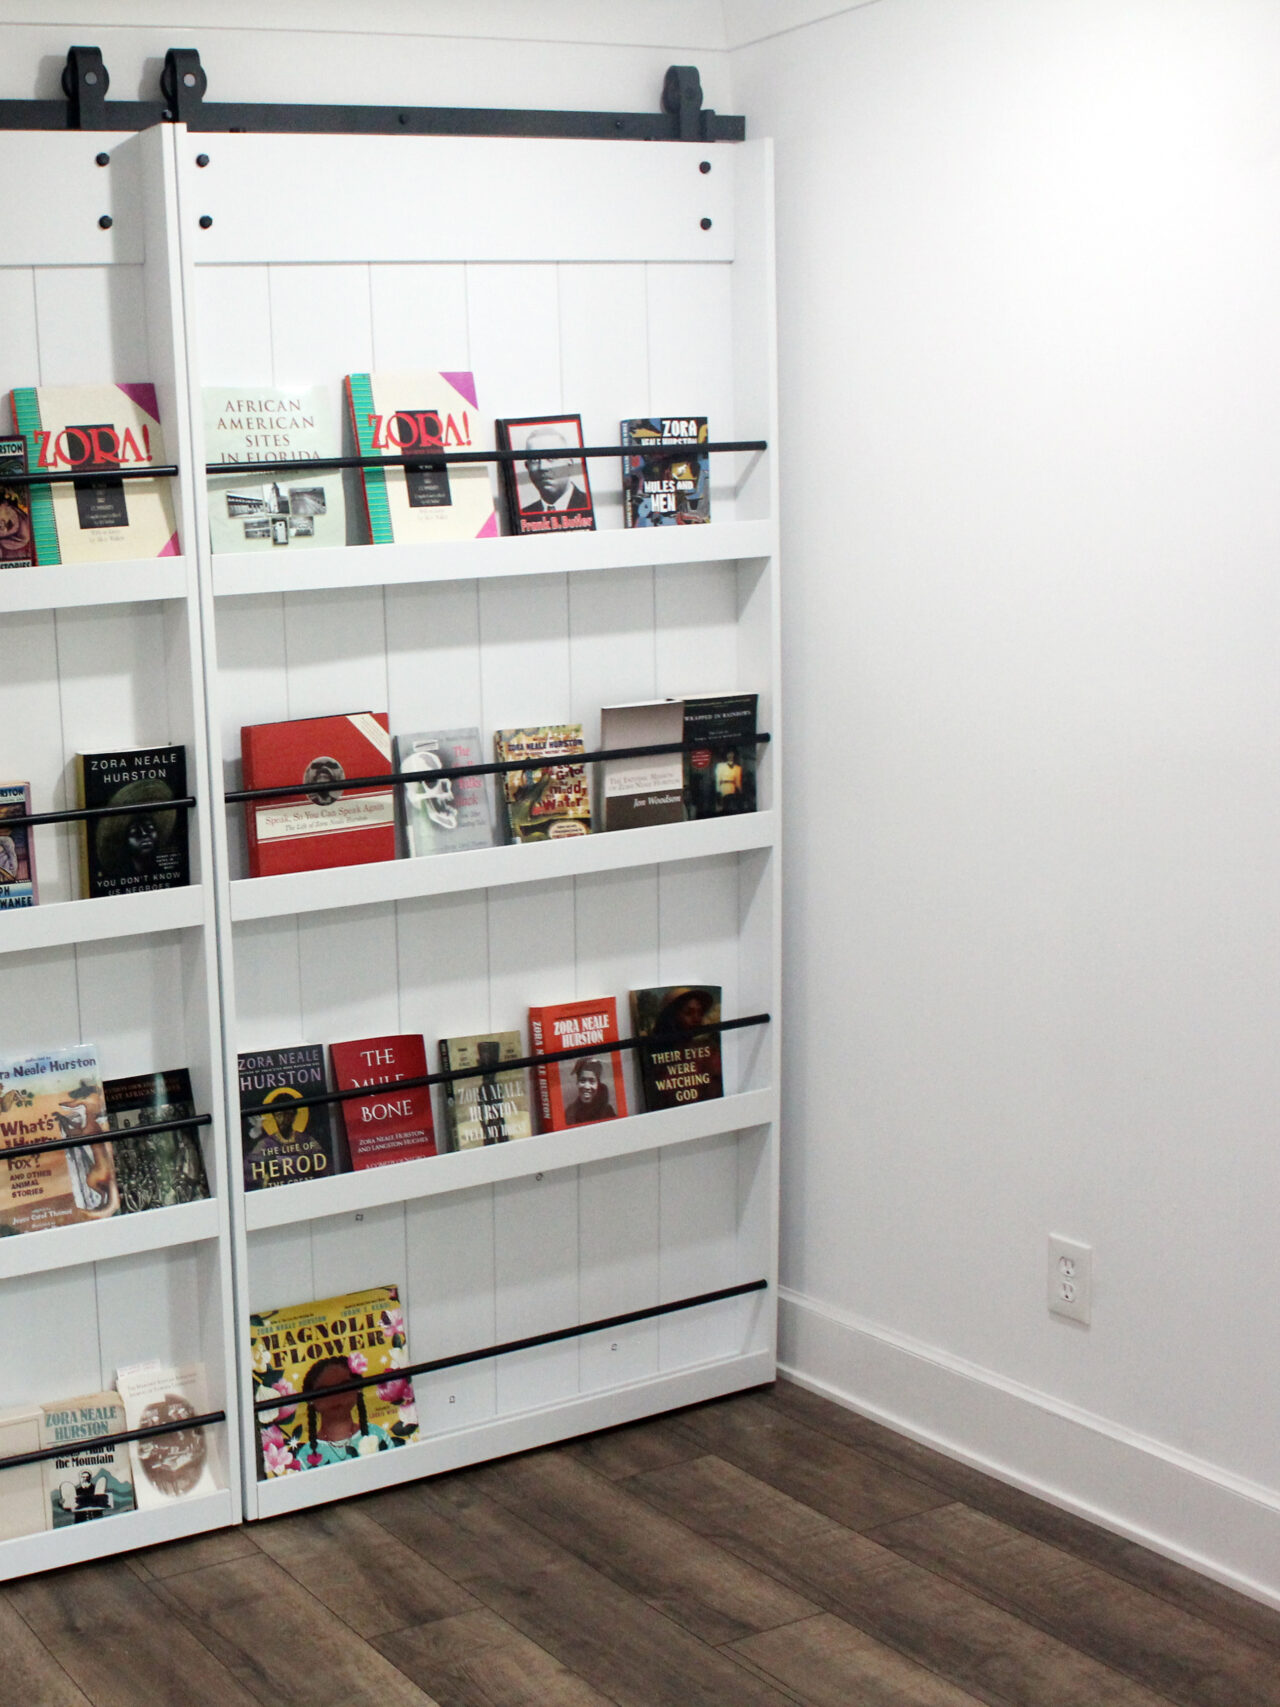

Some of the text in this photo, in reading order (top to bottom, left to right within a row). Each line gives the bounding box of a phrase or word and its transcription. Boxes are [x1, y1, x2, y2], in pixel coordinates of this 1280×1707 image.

[224, 399, 301, 413] AFRICAN
[217, 415, 315, 430] AMERICAN
[368, 411, 472, 449] ZORA!
[661, 419, 698, 437] ZORA
[33, 423, 153, 468] ZORA!
[245, 433, 291, 448] SITES
[221, 452, 240, 463] IN
[643, 479, 695, 494] MULES AND
[651, 493, 677, 513] MEN
[521, 515, 550, 532] Frank
[452, 744, 471, 757] The
[91, 753, 177, 771] ZORA NEALE
[104, 768, 167, 784] HURSTON
[320, 808, 337, 818] Can
[96, 871, 181, 888] YOU DON'T KNOW
[532, 1021, 544, 1046] ZORA
[553, 1013, 610, 1036] ZORA NEALE
[561, 1029, 605, 1049] HURSTON
[239, 1055, 275, 1071] ZORA
[278, 1048, 320, 1066] NEALE
[360, 1047, 396, 1068] THE
[651, 1046, 711, 1065] THEIR EYES
[13, 1062, 47, 1078] Neale
[49, 1058, 97, 1073] Hurston
[666, 1061, 697, 1075] WERE
[240, 1067, 322, 1092] HURSTON
[655, 1072, 711, 1091] WATCHING
[458, 1085, 488, 1105] ZORA
[675, 1088, 699, 1102] GOD
[361, 1099, 413, 1123] BONE
[469, 1101, 519, 1122] HURSTON
[0, 1114, 55, 1137] What's
[486, 1125, 500, 1138] MY
[359, 1130, 426, 1146] ZORA NEALE HURSTON
[262, 1142, 316, 1157] THE LIFE OF
[357, 1145, 371, 1153] AND
[7, 1154, 41, 1171] Fox?
[251, 1152, 328, 1181] HEROD
[9, 1169, 53, 1182] AND OTHER
[11, 1179, 40, 1191] ANIMAL
[11, 1187, 45, 1199] STORIES
[261, 1310, 392, 1351] MAGNOLIA
[272, 1330, 386, 1368] FLOWER
[45, 1406, 117, 1428] ZORA NEALE
[55, 1421, 109, 1441] HURSTON
[55, 1453, 115, 1470] the Mountain
